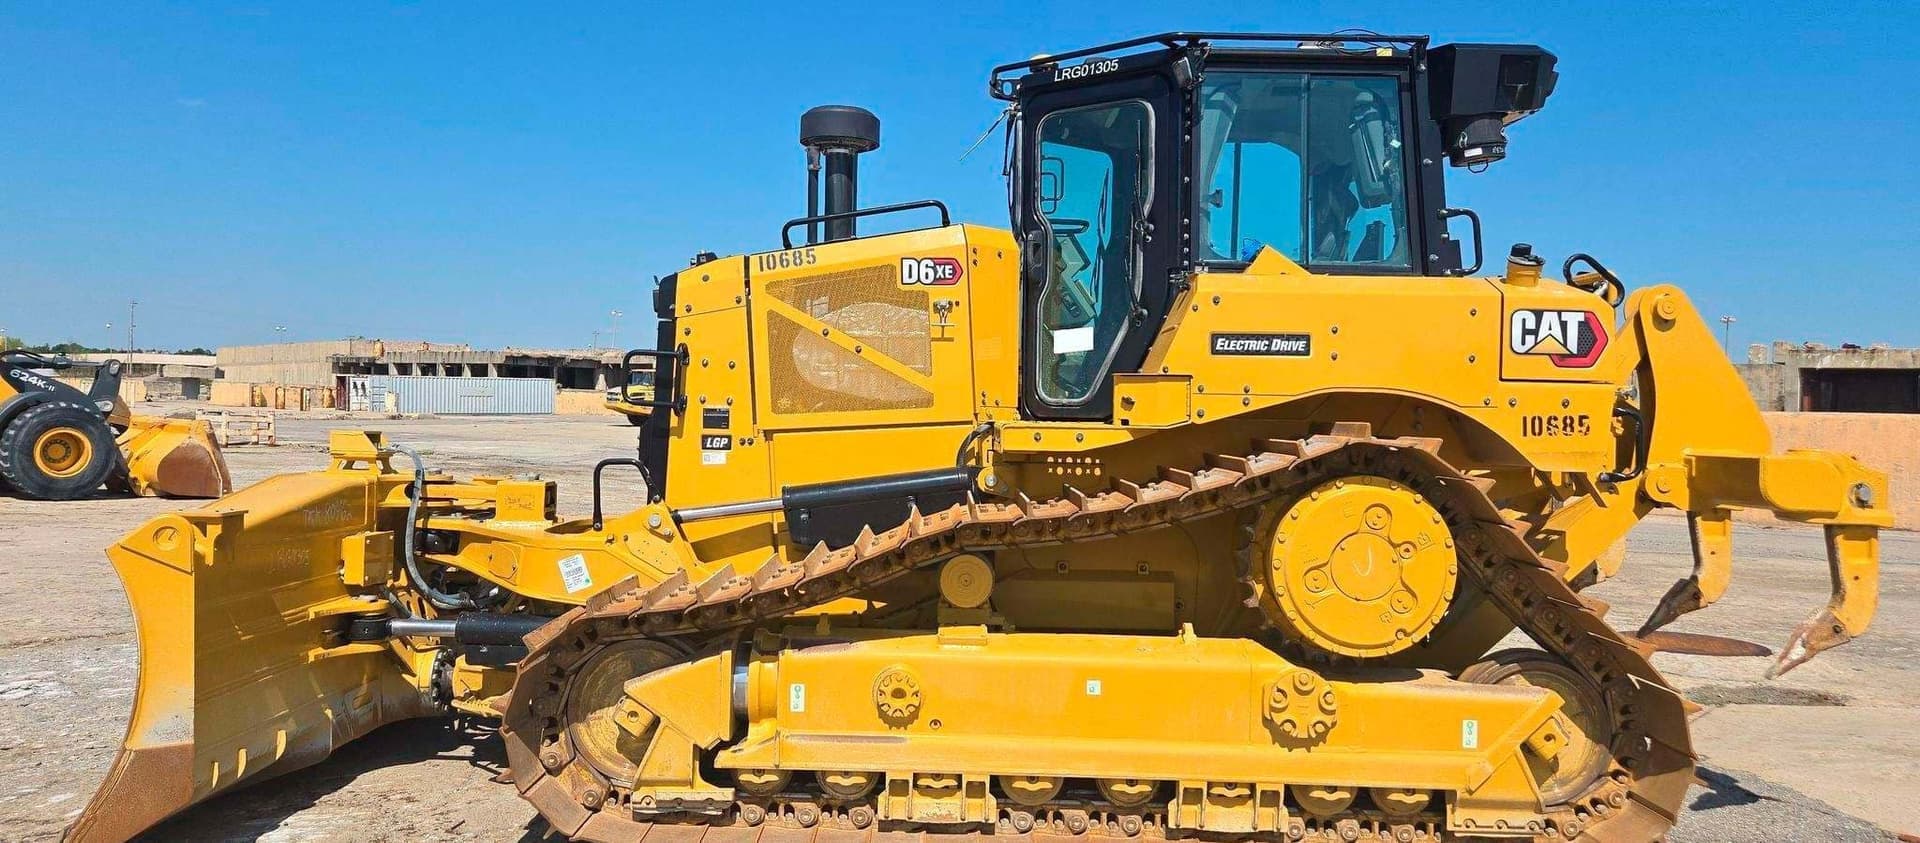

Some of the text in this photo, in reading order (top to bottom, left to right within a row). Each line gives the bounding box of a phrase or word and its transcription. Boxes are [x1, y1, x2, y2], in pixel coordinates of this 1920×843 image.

[1054, 59, 1119, 82] LRG01305
[758, 248, 817, 272] 10685
[1511, 310, 1585, 354] CAT
[1216, 338, 1307, 351] ELECTRIC DRIVE
[1522, 415, 1590, 437] 10685
[706, 437, 729, 449] LGP
